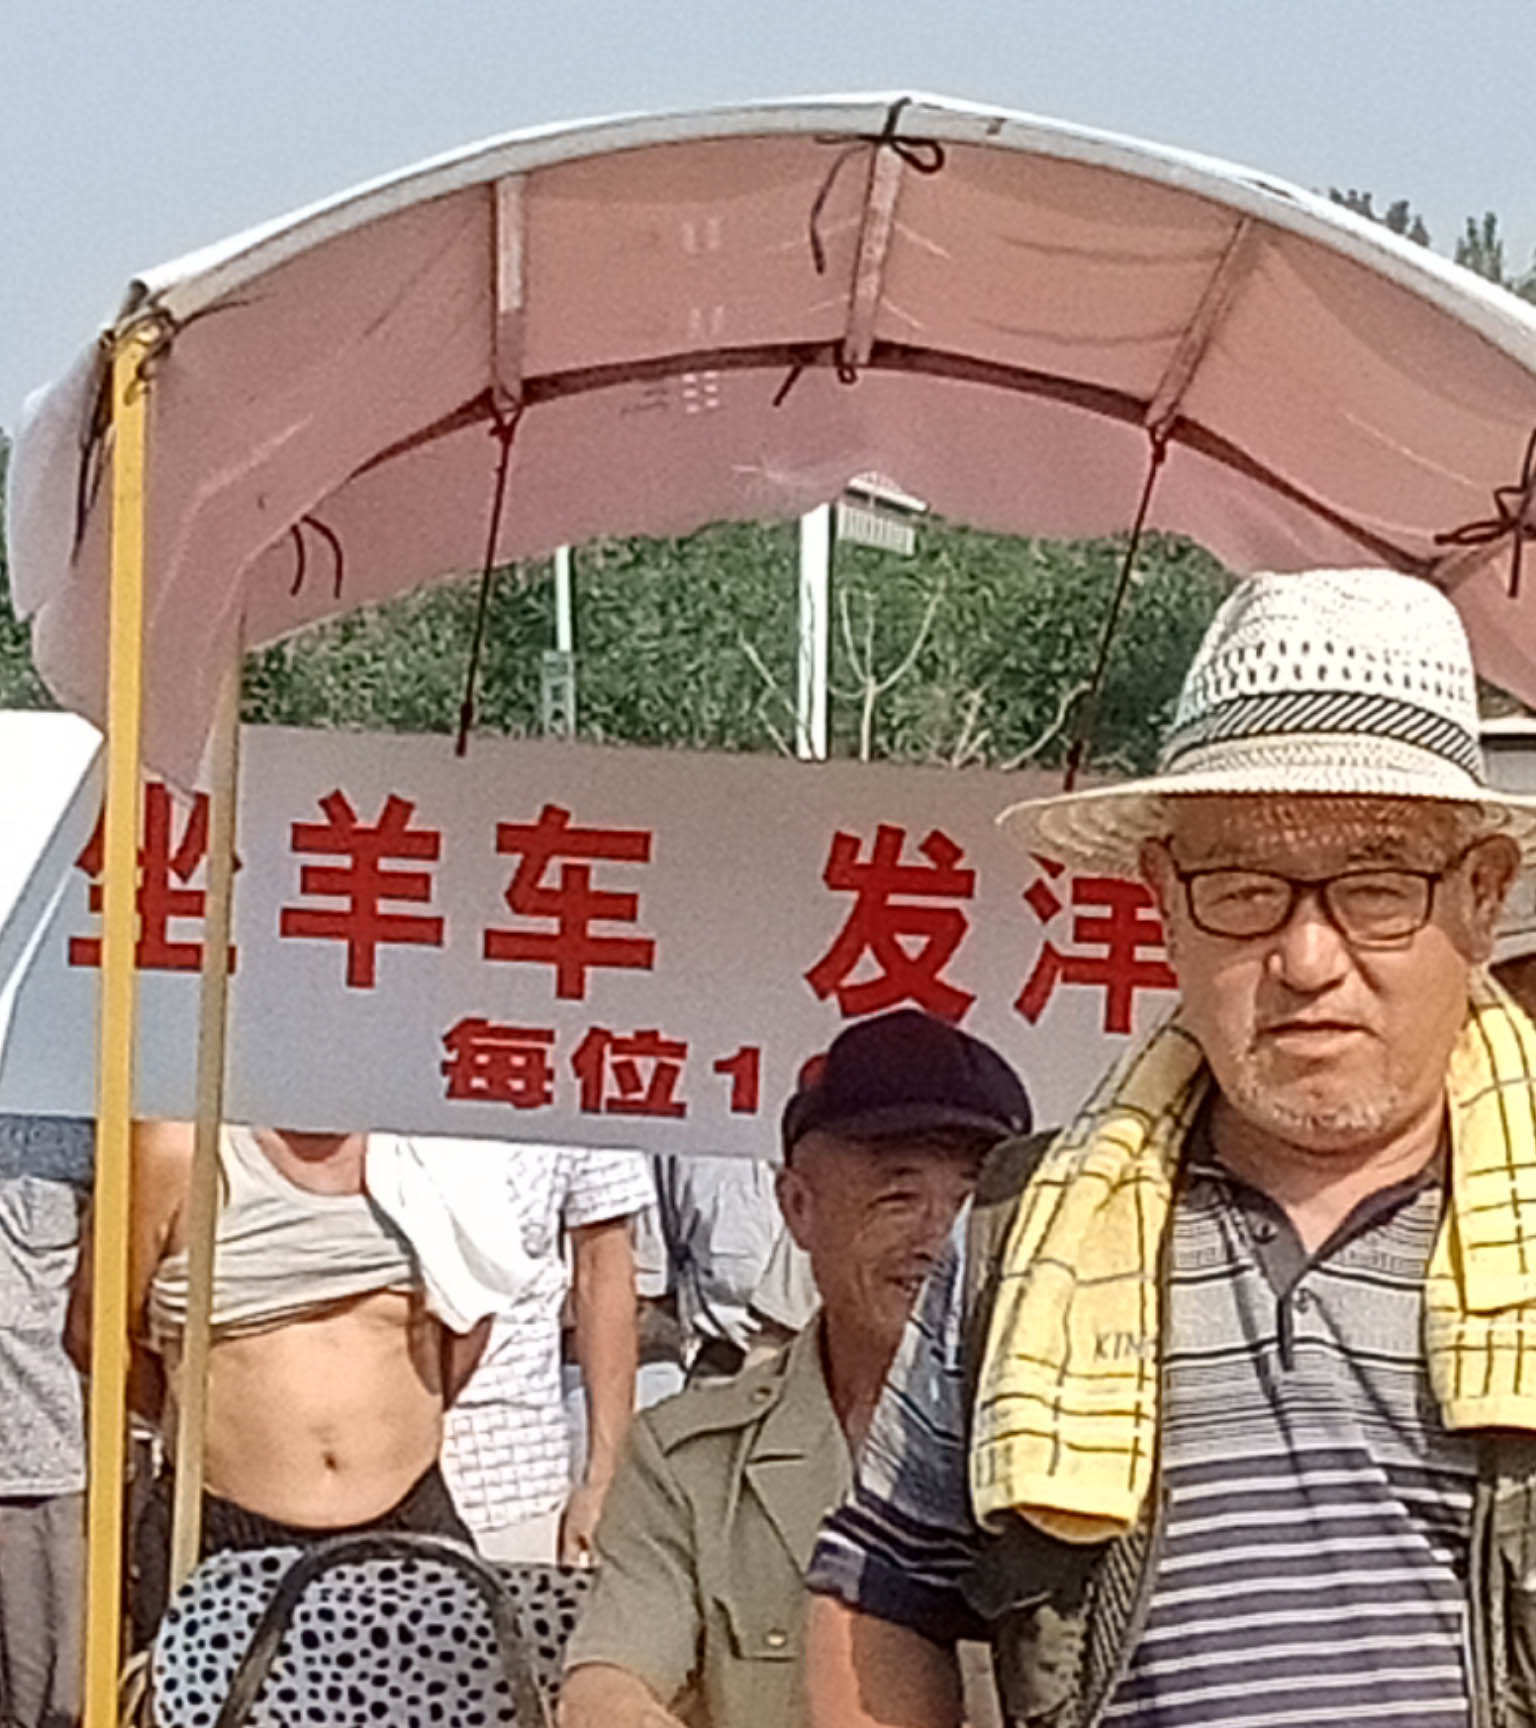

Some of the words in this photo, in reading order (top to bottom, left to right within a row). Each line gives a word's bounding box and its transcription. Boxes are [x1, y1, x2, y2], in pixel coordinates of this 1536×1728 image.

[68, 781, 656, 1000] 坐羊车
[440, 1017, 828, 1118] 每位1
[1095, 1332, 1156, 1361] KIN
